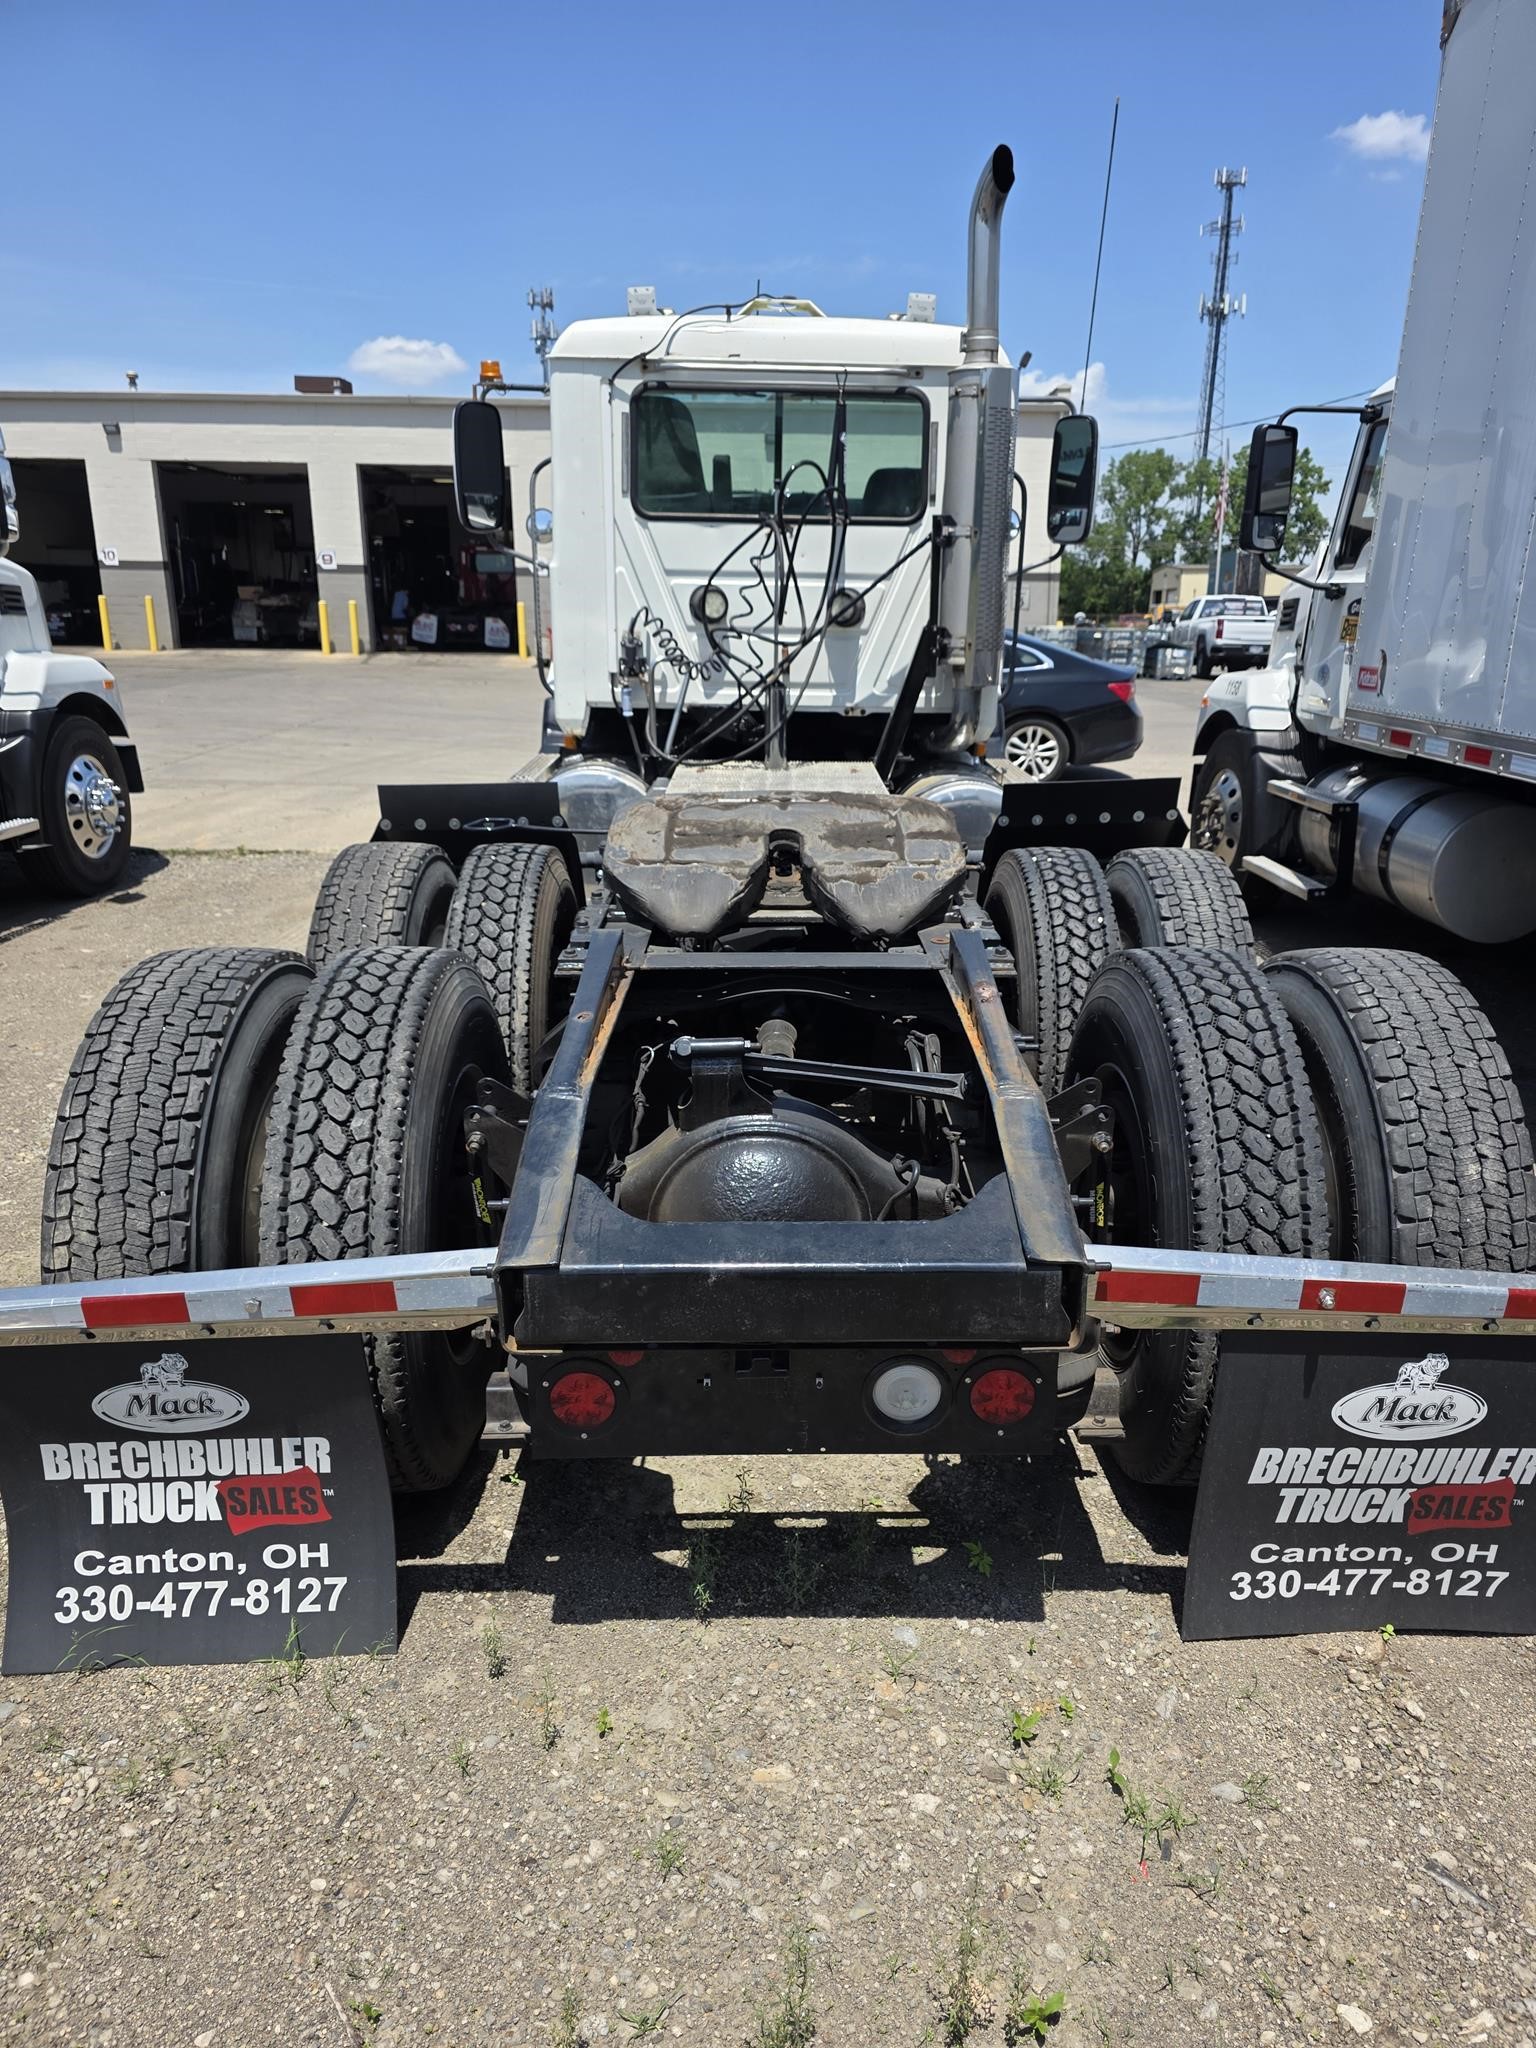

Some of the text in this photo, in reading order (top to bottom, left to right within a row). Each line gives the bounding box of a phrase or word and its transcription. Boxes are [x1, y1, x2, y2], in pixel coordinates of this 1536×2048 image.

[102, 550, 115, 562] 10
[321, 554, 333, 564] 9
[476, 1184, 489, 1219] MONROE
[1096, 1188, 1105, 1222] MONROE
[126, 1389, 225, 1418] Mack
[1360, 1395, 1459, 1424] Mack
[39, 1437, 332, 1481] BRECHBUHLER
[1247, 1447, 1536, 1485] BRECHBUHLER
[84, 1480, 223, 1525] TRUCK
[228, 1486, 318, 1517] SALES
[1274, 1488, 1418, 1524] TRUCK
[1413, 1494, 1508, 1522] SALES
[73, 1543, 329, 1576] Canton, OH
[1250, 1542, 1499, 1565] Canton, OH
[54, 1576, 348, 1624] 330-477-8127
[1228, 1569, 1510, 1601] 330-477-8127
